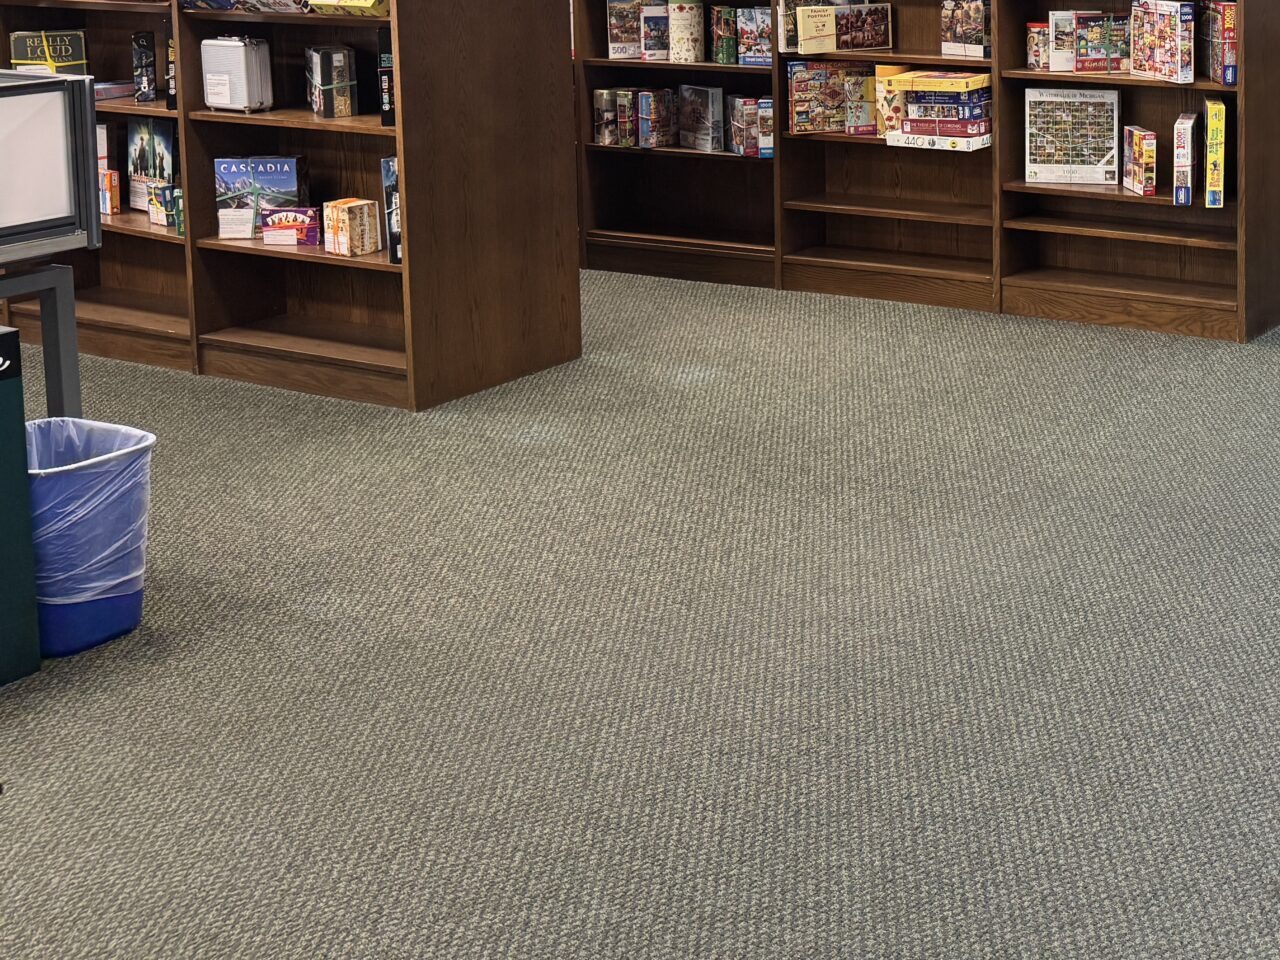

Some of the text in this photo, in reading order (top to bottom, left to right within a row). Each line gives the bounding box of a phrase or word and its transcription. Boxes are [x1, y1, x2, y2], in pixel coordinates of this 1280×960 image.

[1224, 10, 1233, 29] 1000
[26, 36, 72, 47] RELLY
[27, 45, 73, 58] LOUD
[612, 46, 627, 54] 500
[141, 76, 149, 91] Clue
[904, 136, 924, 146] 440
[1177, 132, 1186, 150] 1000
[220, 163, 291, 174] CASCADIA
